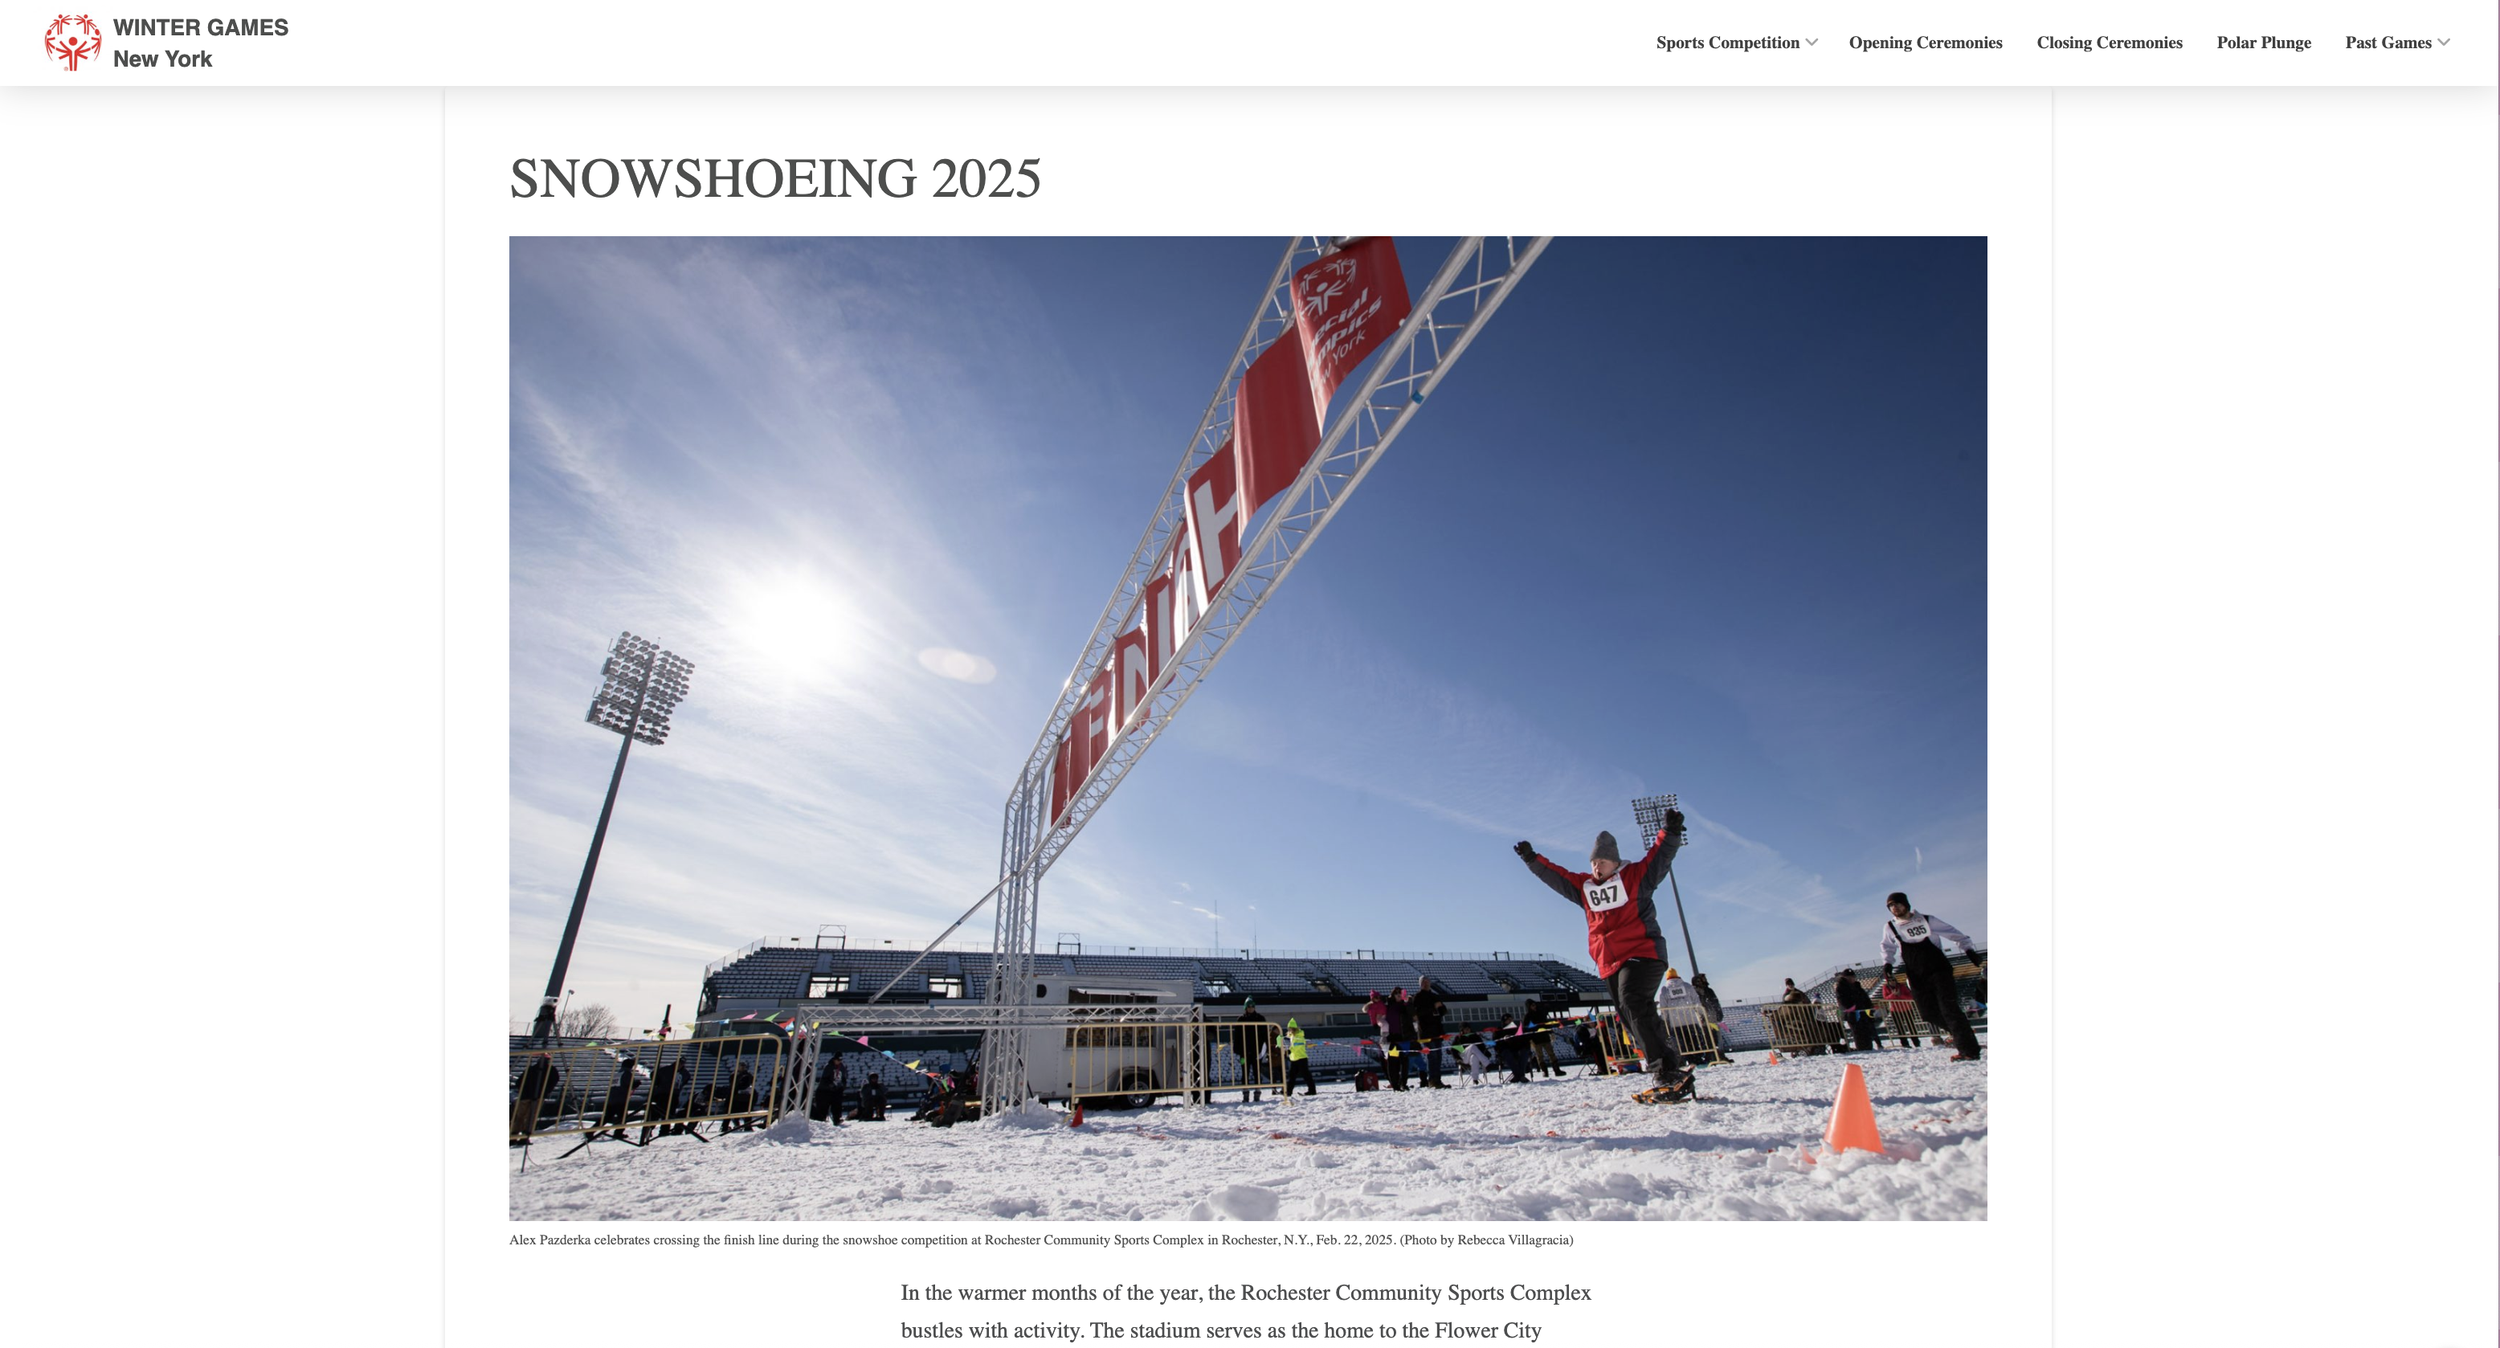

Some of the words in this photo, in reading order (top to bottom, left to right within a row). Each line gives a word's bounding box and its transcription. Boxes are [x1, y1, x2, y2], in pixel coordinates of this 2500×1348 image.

[112, 18, 201, 36] WINTER
[207, 17, 289, 37] GAMES
[1656, 35, 1705, 53] Sports
[1708, 35, 1801, 53] Competition
[1849, 35, 1913, 53] Opening
[1916, 35, 2004, 50] Ceremonies
[2036, 35, 2093, 53] Closing
[2096, 35, 2184, 50] Ceremonies
[2216, 35, 2258, 50] Polar
[2260, 35, 2312, 53] Plunge
[2345, 35, 2378, 50] Past
[2381, 35, 2433, 50] Games
[113, 49, 160, 68] New
[164, 49, 213, 68] York
[510, 157, 918, 199] SNOWSHOEING
[932, 157, 1041, 199] 2025
[1310, 286, 1368, 358] ecial
[1316, 295, 1382, 370] mpics
[1090, 479, 1239, 738] FNISH
[1590, 884, 1618, 906] 647
[1906, 924, 1927, 938] 935
[509, 1234, 537, 1246] Alex
[539, 1234, 592, 1246] Pazderka
[593, 1234, 651, 1246] celebrates
[653, 1234, 700, 1249] crossing
[703, 1234, 721, 1246] the
[723, 1234, 755, 1246] finish
[758, 1234, 780, 1246] line
[782, 1234, 820, 1249] during
[822, 1234, 840, 1246] the
[842, 1234, 899, 1246] snowshoe
[900, 1234, 968, 1249] competition
[971, 1235, 982, 1246] at
[984, 1234, 1042, 1246] Rochester
[1043, 1234, 1111, 1249] Community
[1113, 1234, 1150, 1249] Sports
[1152, 1234, 1204, 1249] Complex
[1207, 1234, 1219, 1246] in
[1221, 1234, 1282, 1247] Rochester,
[1283, 1234, 1314, 1247] N.Y.,
[1316, 1234, 1341, 1246] Feb.
[1343, 1234, 1363, 1247] 22,
[1364, 1234, 1397, 1246] 2025.
[1399, 1234, 1438, 1248] (Photo
[1440, 1234, 1455, 1249] by
[1457, 1234, 1506, 1246] Rebecca
[1508, 1234, 1574, 1249] Villagracia)
[900, 1283, 920, 1301] In
[925, 1283, 953, 1301] the
[957, 1288, 1027, 1301] warmer
[1031, 1283, 1098, 1301] months
[1102, 1283, 1124, 1301] of
[1126, 1283, 1155, 1301] the
[1159, 1288, 1204, 1306] year,
[1208, 1283, 1236, 1301] the
[1240, 1283, 1331, 1301] Rochester
[1335, 1283, 1442, 1306] Community
[1447, 1283, 1505, 1306] Sports
[1510, 1283, 1593, 1306] Complex
[900, 1321, 963, 1339] bustles
[968, 1321, 1009, 1339] with
[1013, 1321, 1085, 1344] activity.
[1089, 1321, 1125, 1339] The
[1130, 1321, 1202, 1339] stadium
[1206, 1326, 1262, 1339] serves
[1267, 1326, 1286, 1339] as
[1291, 1321, 1319, 1339] the
[1323, 1321, 1374, 1339] home
[1379, 1324, 1397, 1339] to
[1402, 1321, 1430, 1339] the
[1434, 1321, 1499, 1339] Flower
[1503, 1321, 1543, 1344] City
